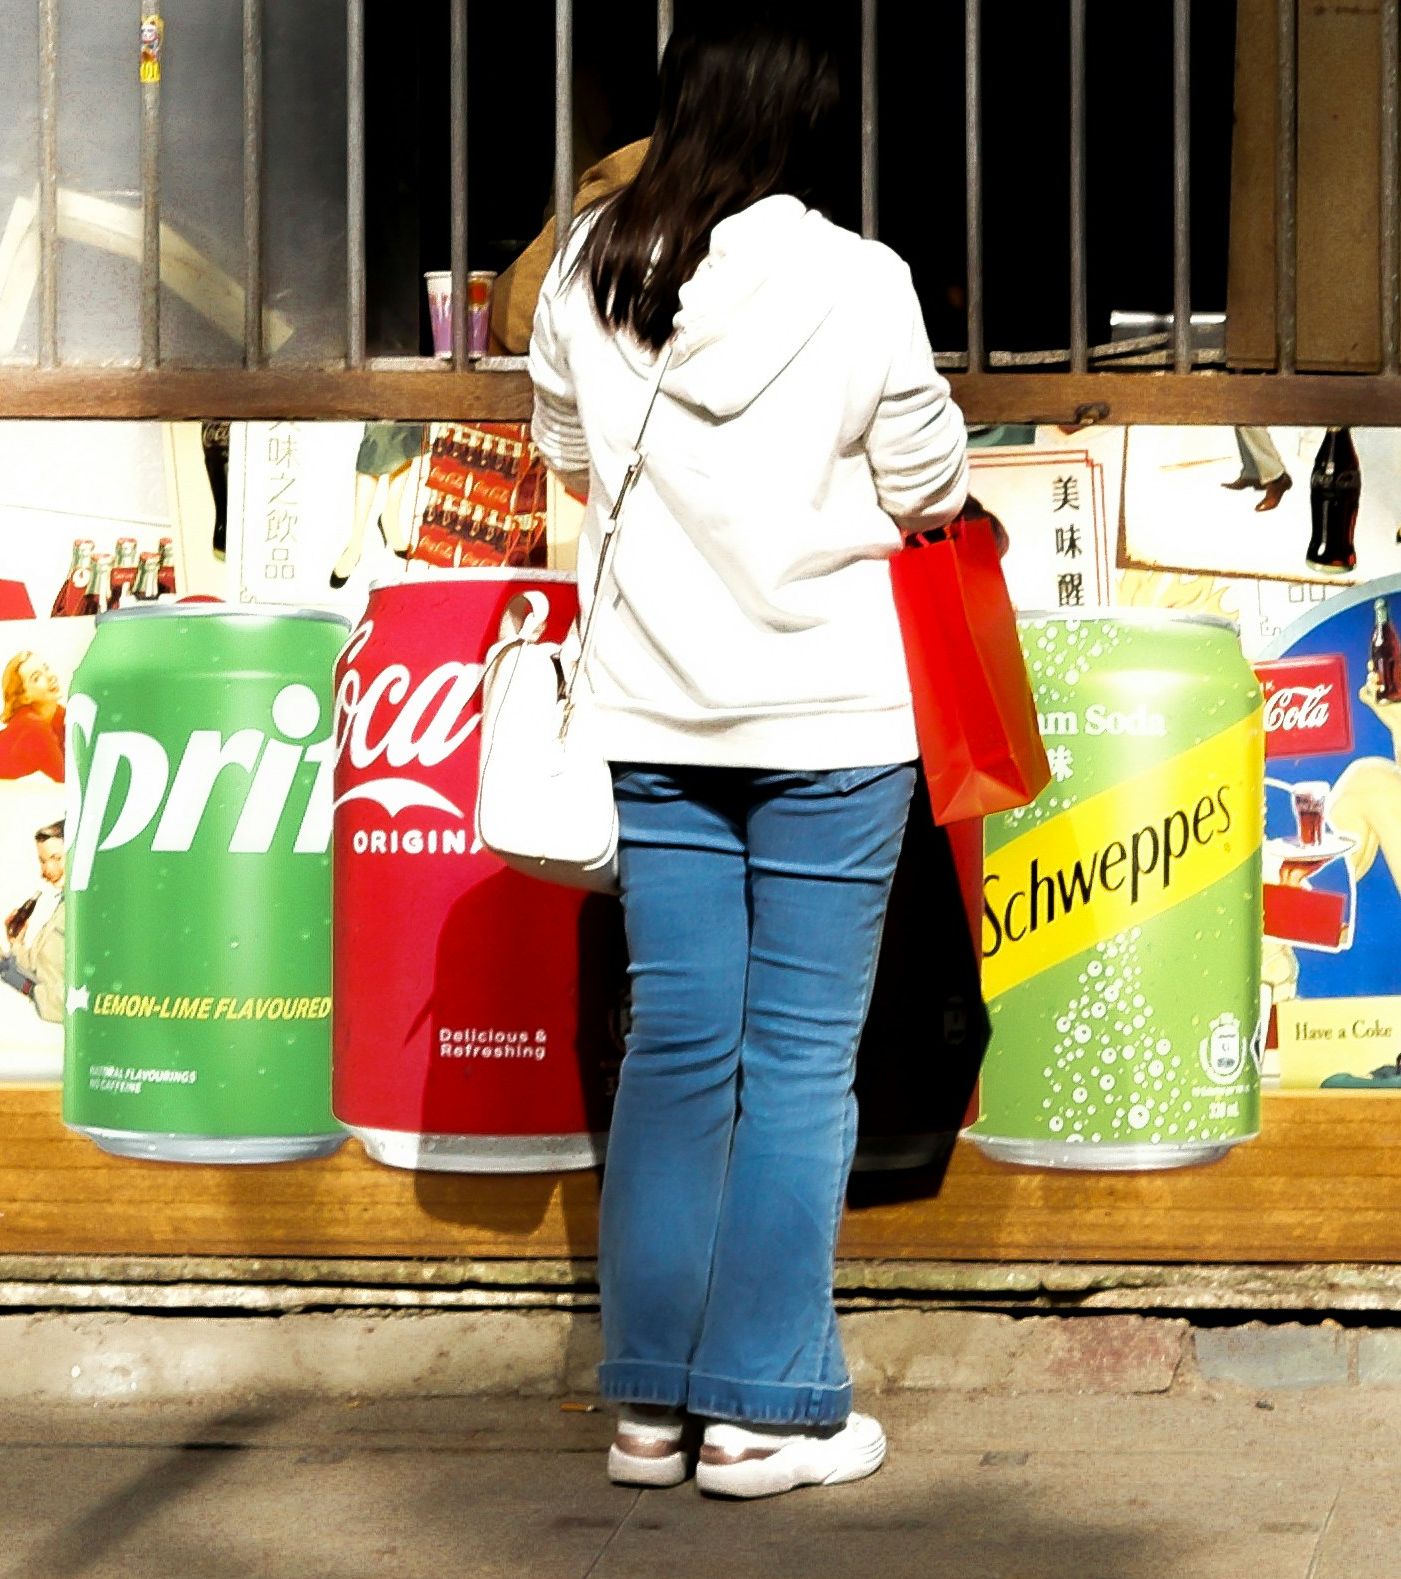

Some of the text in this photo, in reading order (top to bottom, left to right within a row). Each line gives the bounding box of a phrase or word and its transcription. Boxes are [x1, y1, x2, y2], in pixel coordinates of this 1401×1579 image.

[1084, 704, 1166, 736] Soda
[982, 784, 1232, 958] Schweppes
[93, 993, 332, 1020] LEMON-LIME FLAVOURED
[439, 1027, 548, 1043] Delicious &
[1295, 1018, 1392, 1041] Have a Coke
[439, 1043, 547, 1061] Refreshing
